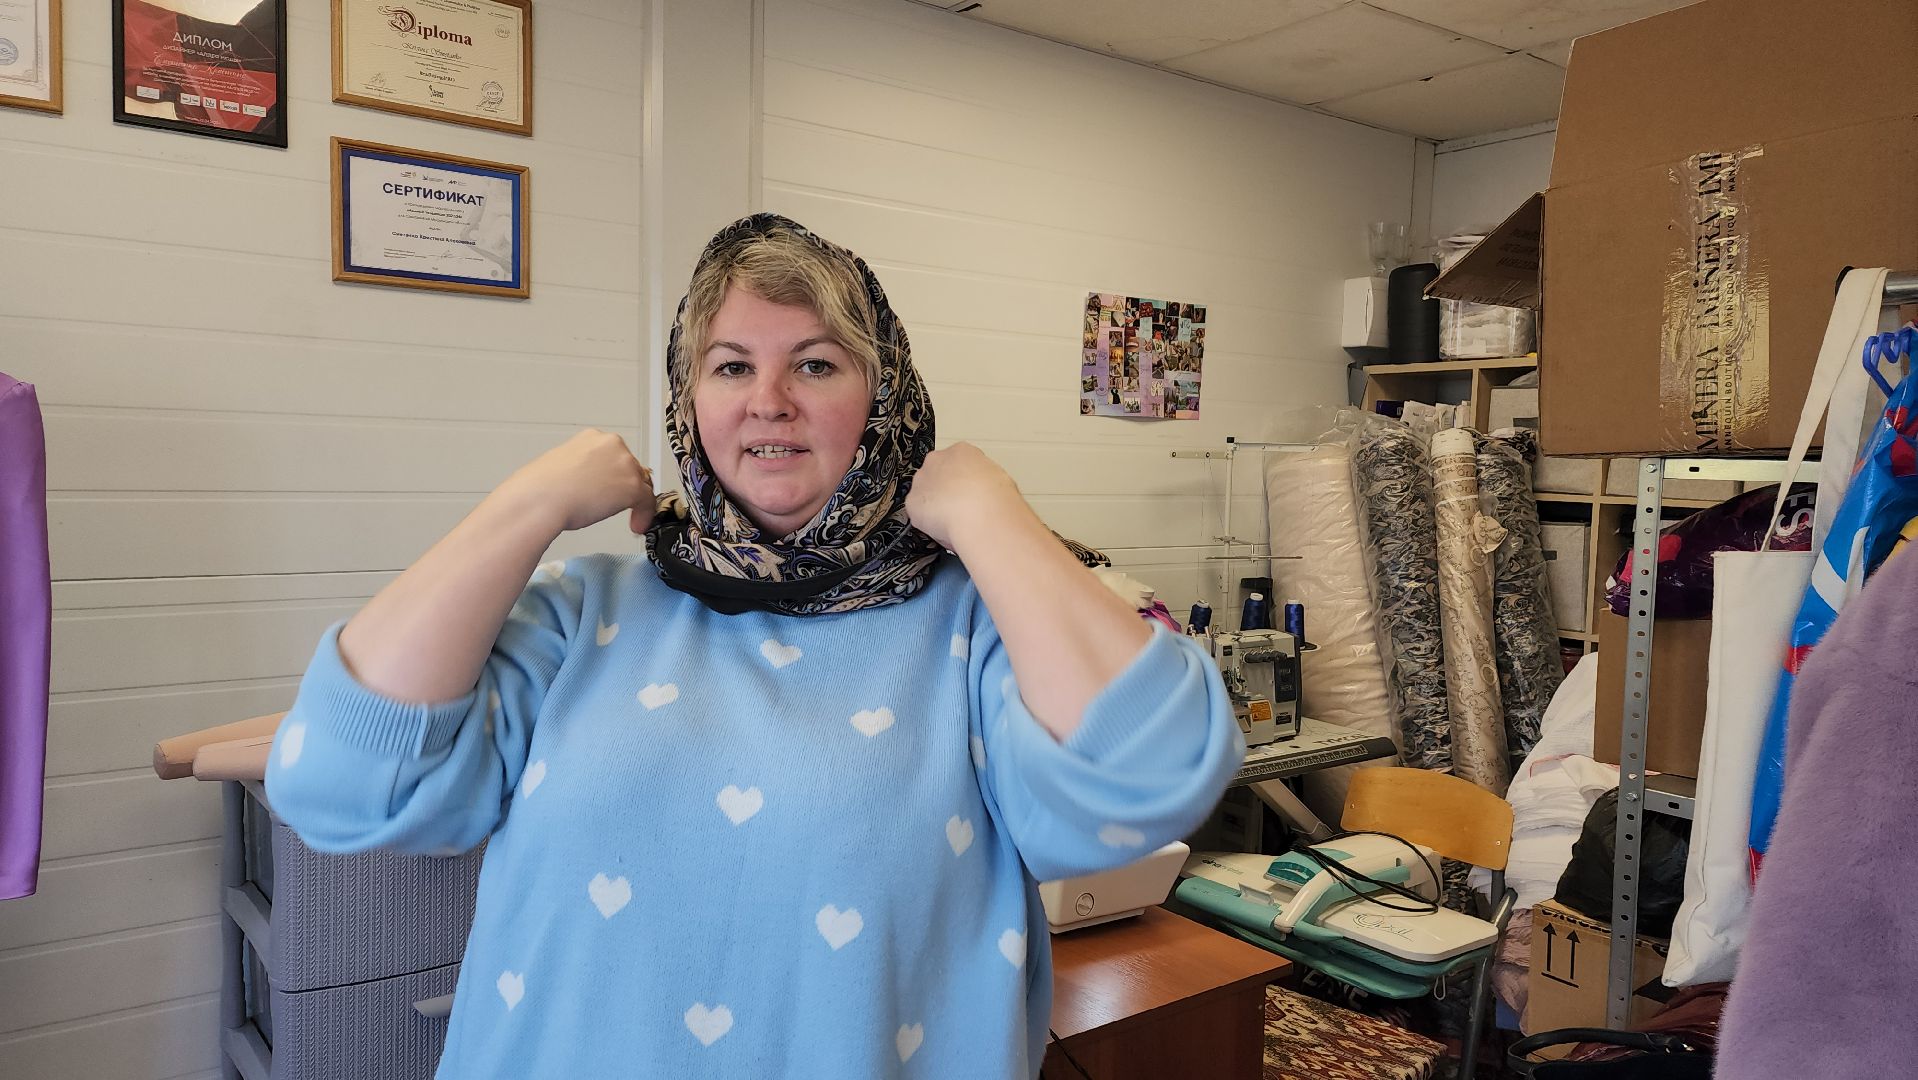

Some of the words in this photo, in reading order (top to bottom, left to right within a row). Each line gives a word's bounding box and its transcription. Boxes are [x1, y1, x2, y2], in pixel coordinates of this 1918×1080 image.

[173, 32, 233, 52] ДИПЛОМ
[384, 7, 473, 46] Diploma
[382, 182, 485, 207] СЕРТИФИКАТ
[1724, 397, 1733, 451] ANNEQUIN
